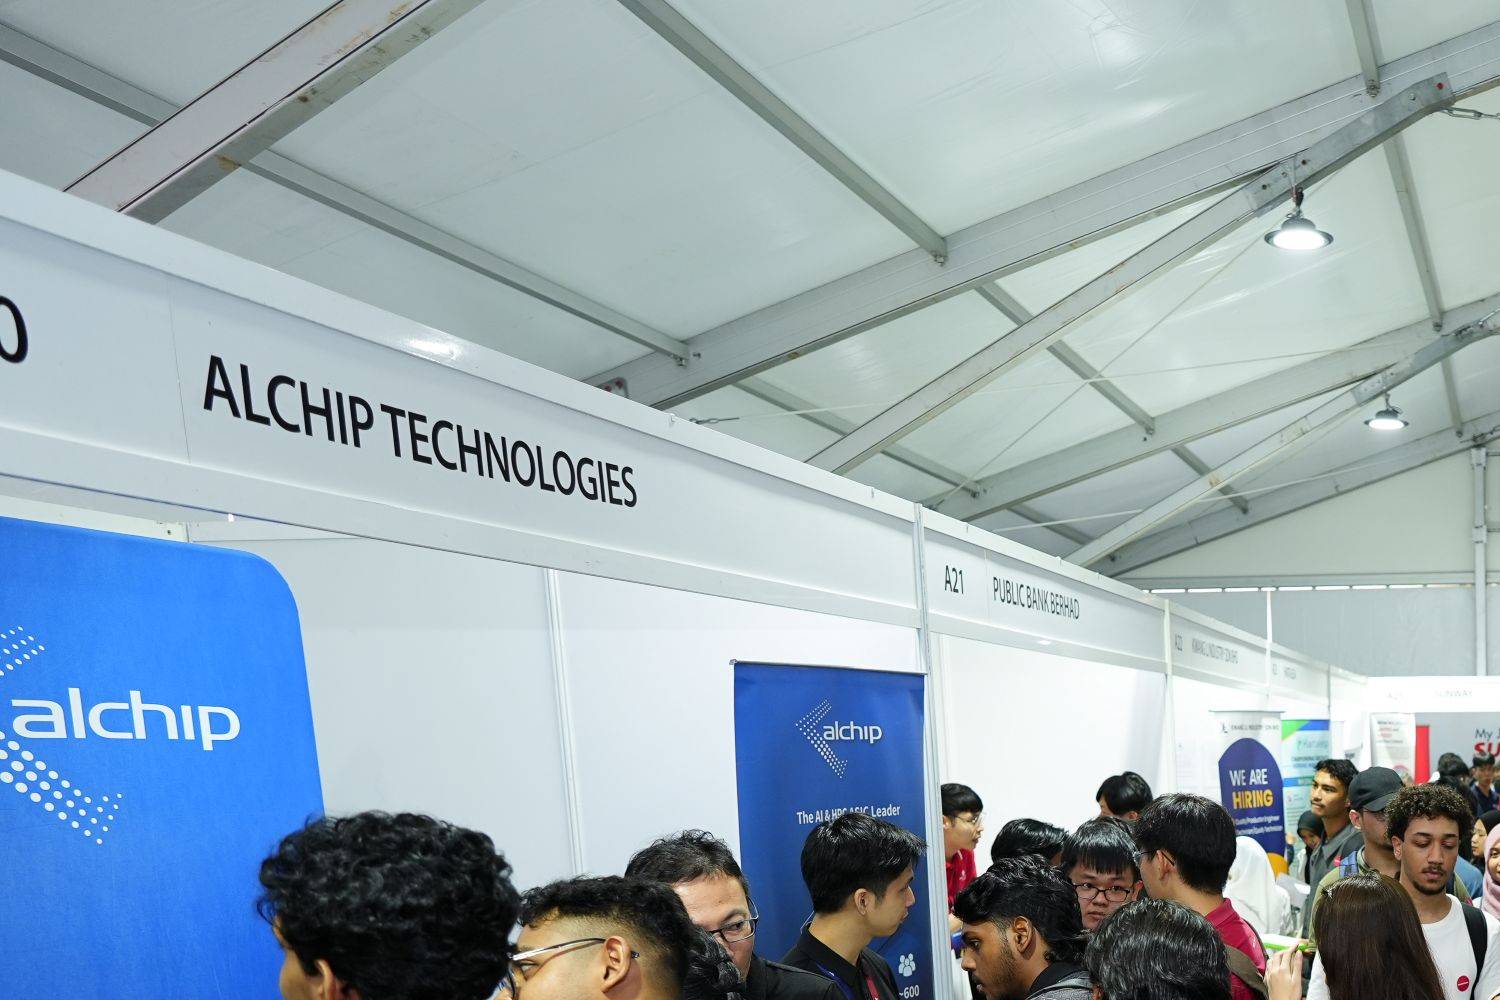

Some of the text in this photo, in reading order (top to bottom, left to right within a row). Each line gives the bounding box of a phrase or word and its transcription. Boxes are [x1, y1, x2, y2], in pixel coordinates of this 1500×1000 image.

[202, 353, 639, 508] ALCHIP TECHNOLOGIES
[944, 565, 1080, 620] A21 PUBLIC BANK BERHAD
[11, 687, 241, 751] alchip
[822, 720, 883, 744] alchip
[1475, 728, 1492, 741] My
[1229, 768, 1268, 786] WE ARE
[1232, 788, 1274, 810] HIRING
[796, 811, 814, 825] The
[824, 809, 831, 821] &
[870, 804, 901, 818] Leader
